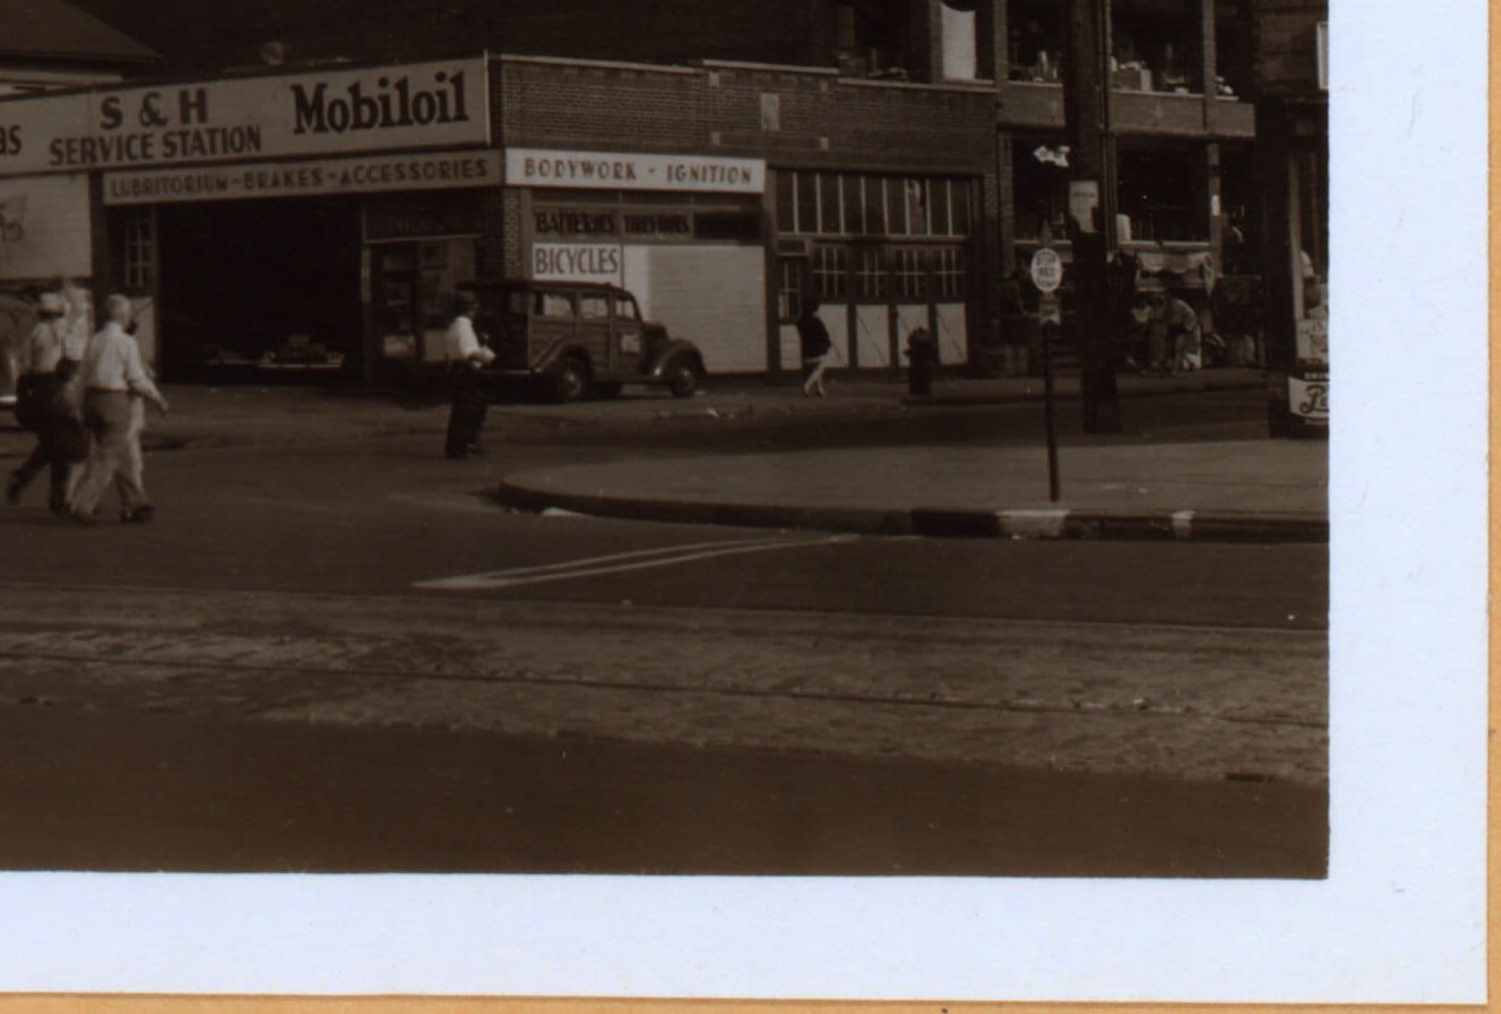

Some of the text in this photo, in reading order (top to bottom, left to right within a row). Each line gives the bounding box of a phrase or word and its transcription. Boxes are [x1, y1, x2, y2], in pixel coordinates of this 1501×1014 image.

[99, 88, 209, 130] S & H
[290, 70, 469, 135] Mobiloil
[49, 124, 263, 167] SERVICE STATION
[524, 158, 637, 180] BODYWORK
[666, 163, 752, 184] IGNITION
[534, 247, 619, 275] BICYCLES
